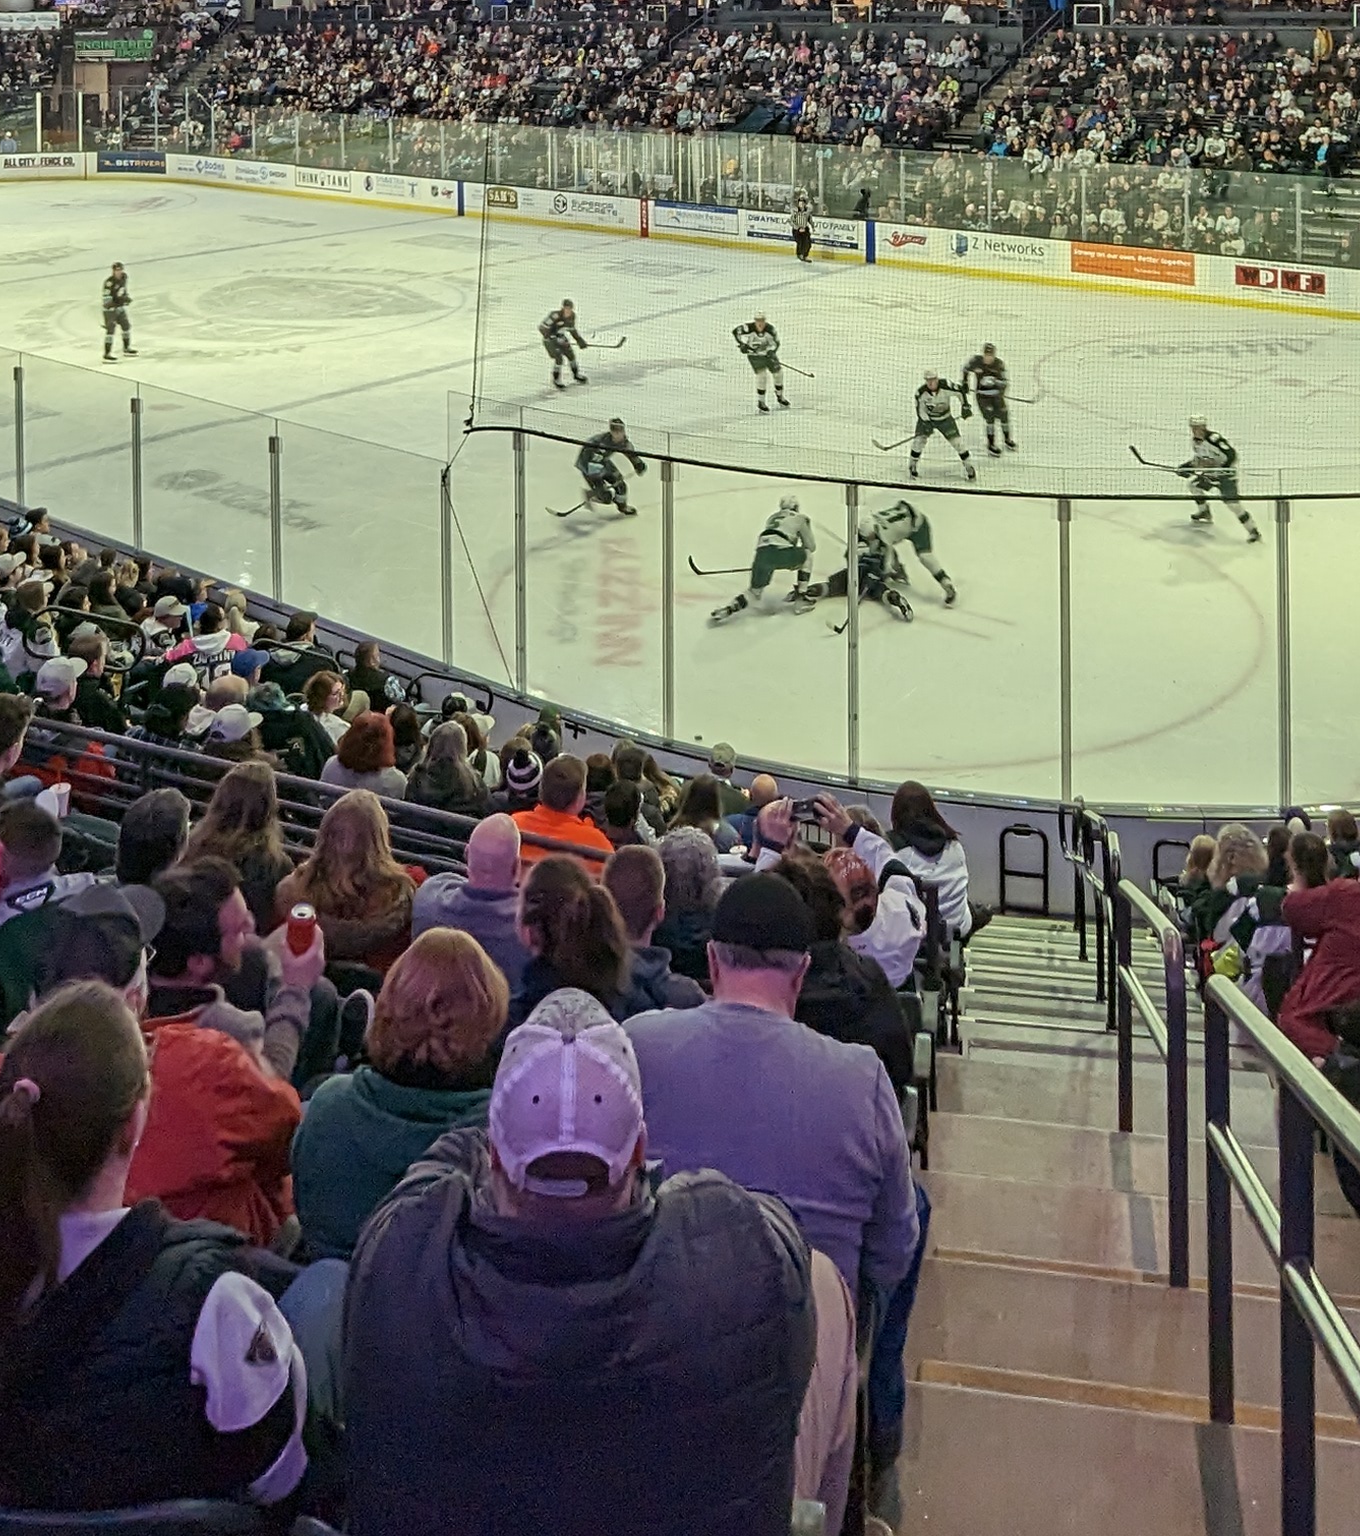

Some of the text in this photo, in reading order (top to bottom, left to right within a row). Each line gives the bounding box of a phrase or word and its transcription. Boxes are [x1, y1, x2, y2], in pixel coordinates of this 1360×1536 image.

[75, 40, 154, 51] ENGINEERED
[3, 157, 75, 168] ALL CITY FENCE CO.
[115, 159, 165, 168] BETRIVERS
[298, 170, 349, 189] THINK TANK
[972, 237, 1045, 257] Z Networks
[1073, 249, 1095, 259] Strong
[1096, 251, 1106, 259] on
[1138, 254, 1159, 264] Better
[1241, 268, 1275, 285] WP
[15, 886, 49, 904] CCM
